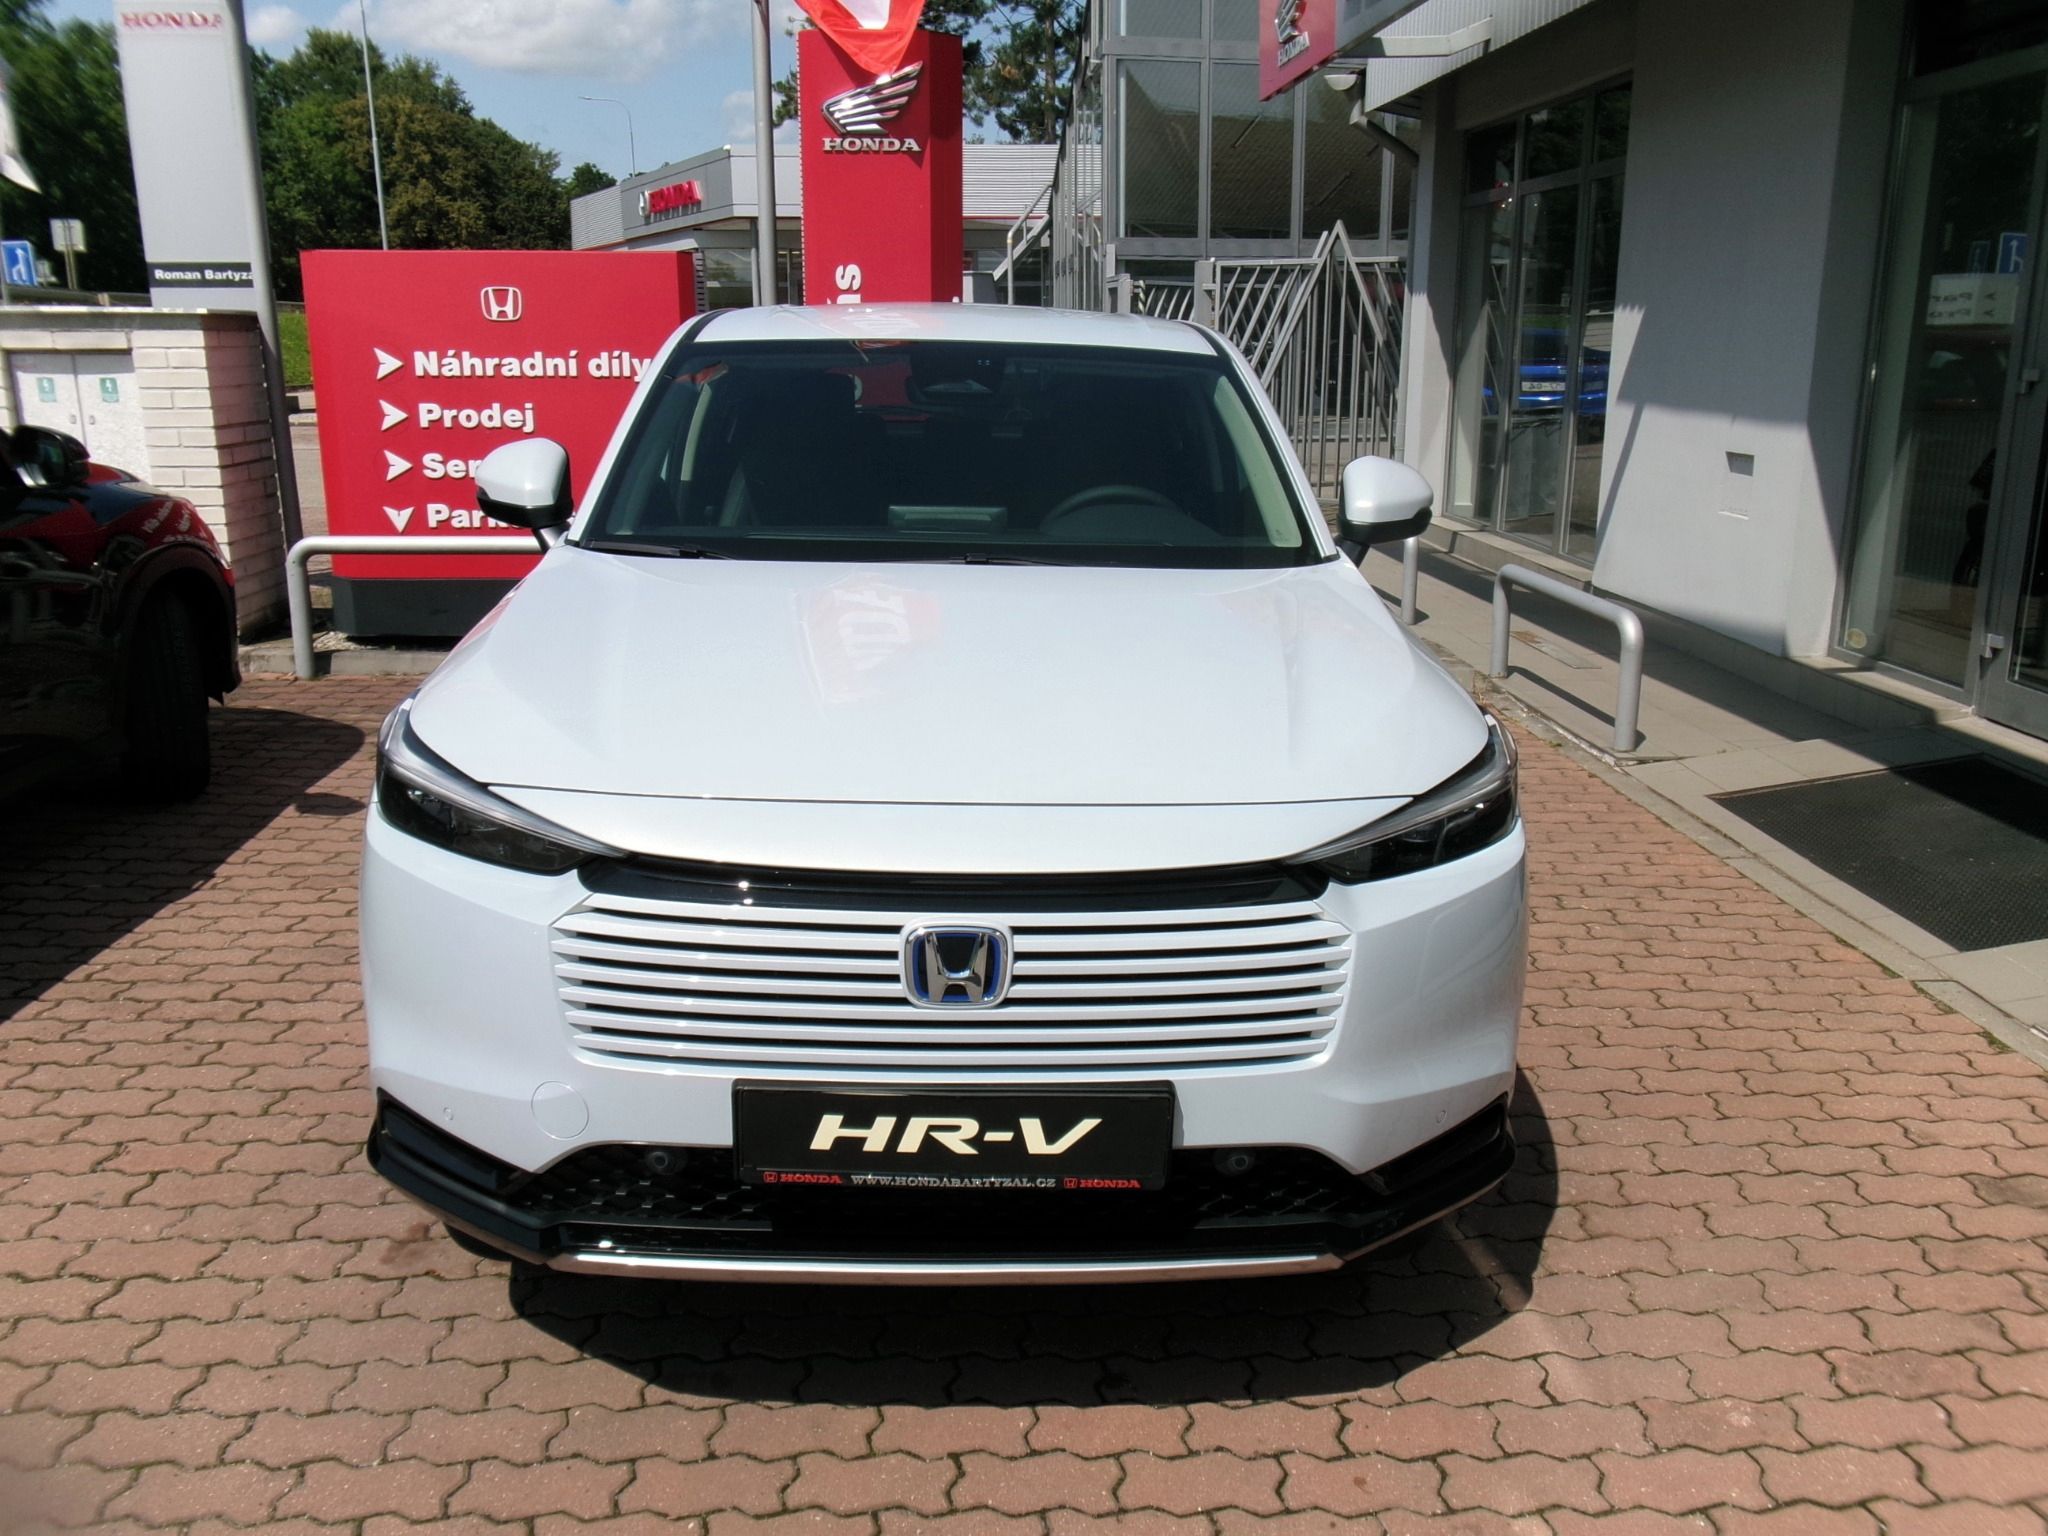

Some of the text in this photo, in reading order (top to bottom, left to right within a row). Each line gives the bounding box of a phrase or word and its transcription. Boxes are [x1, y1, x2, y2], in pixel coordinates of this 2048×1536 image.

[822, 137, 922, 153] HONDA
[154, 269, 201, 280] Roman
[413, 351, 651, 382] Náhradní díly
[418, 402, 535, 433] Prodej
[422, 453, 482, 479] Ser
[810, 1114, 1103, 1155] HR-V
[780, 1173, 1141, 1189] HONDA WWW.HONDABARTYZAL.CZ HONDA
